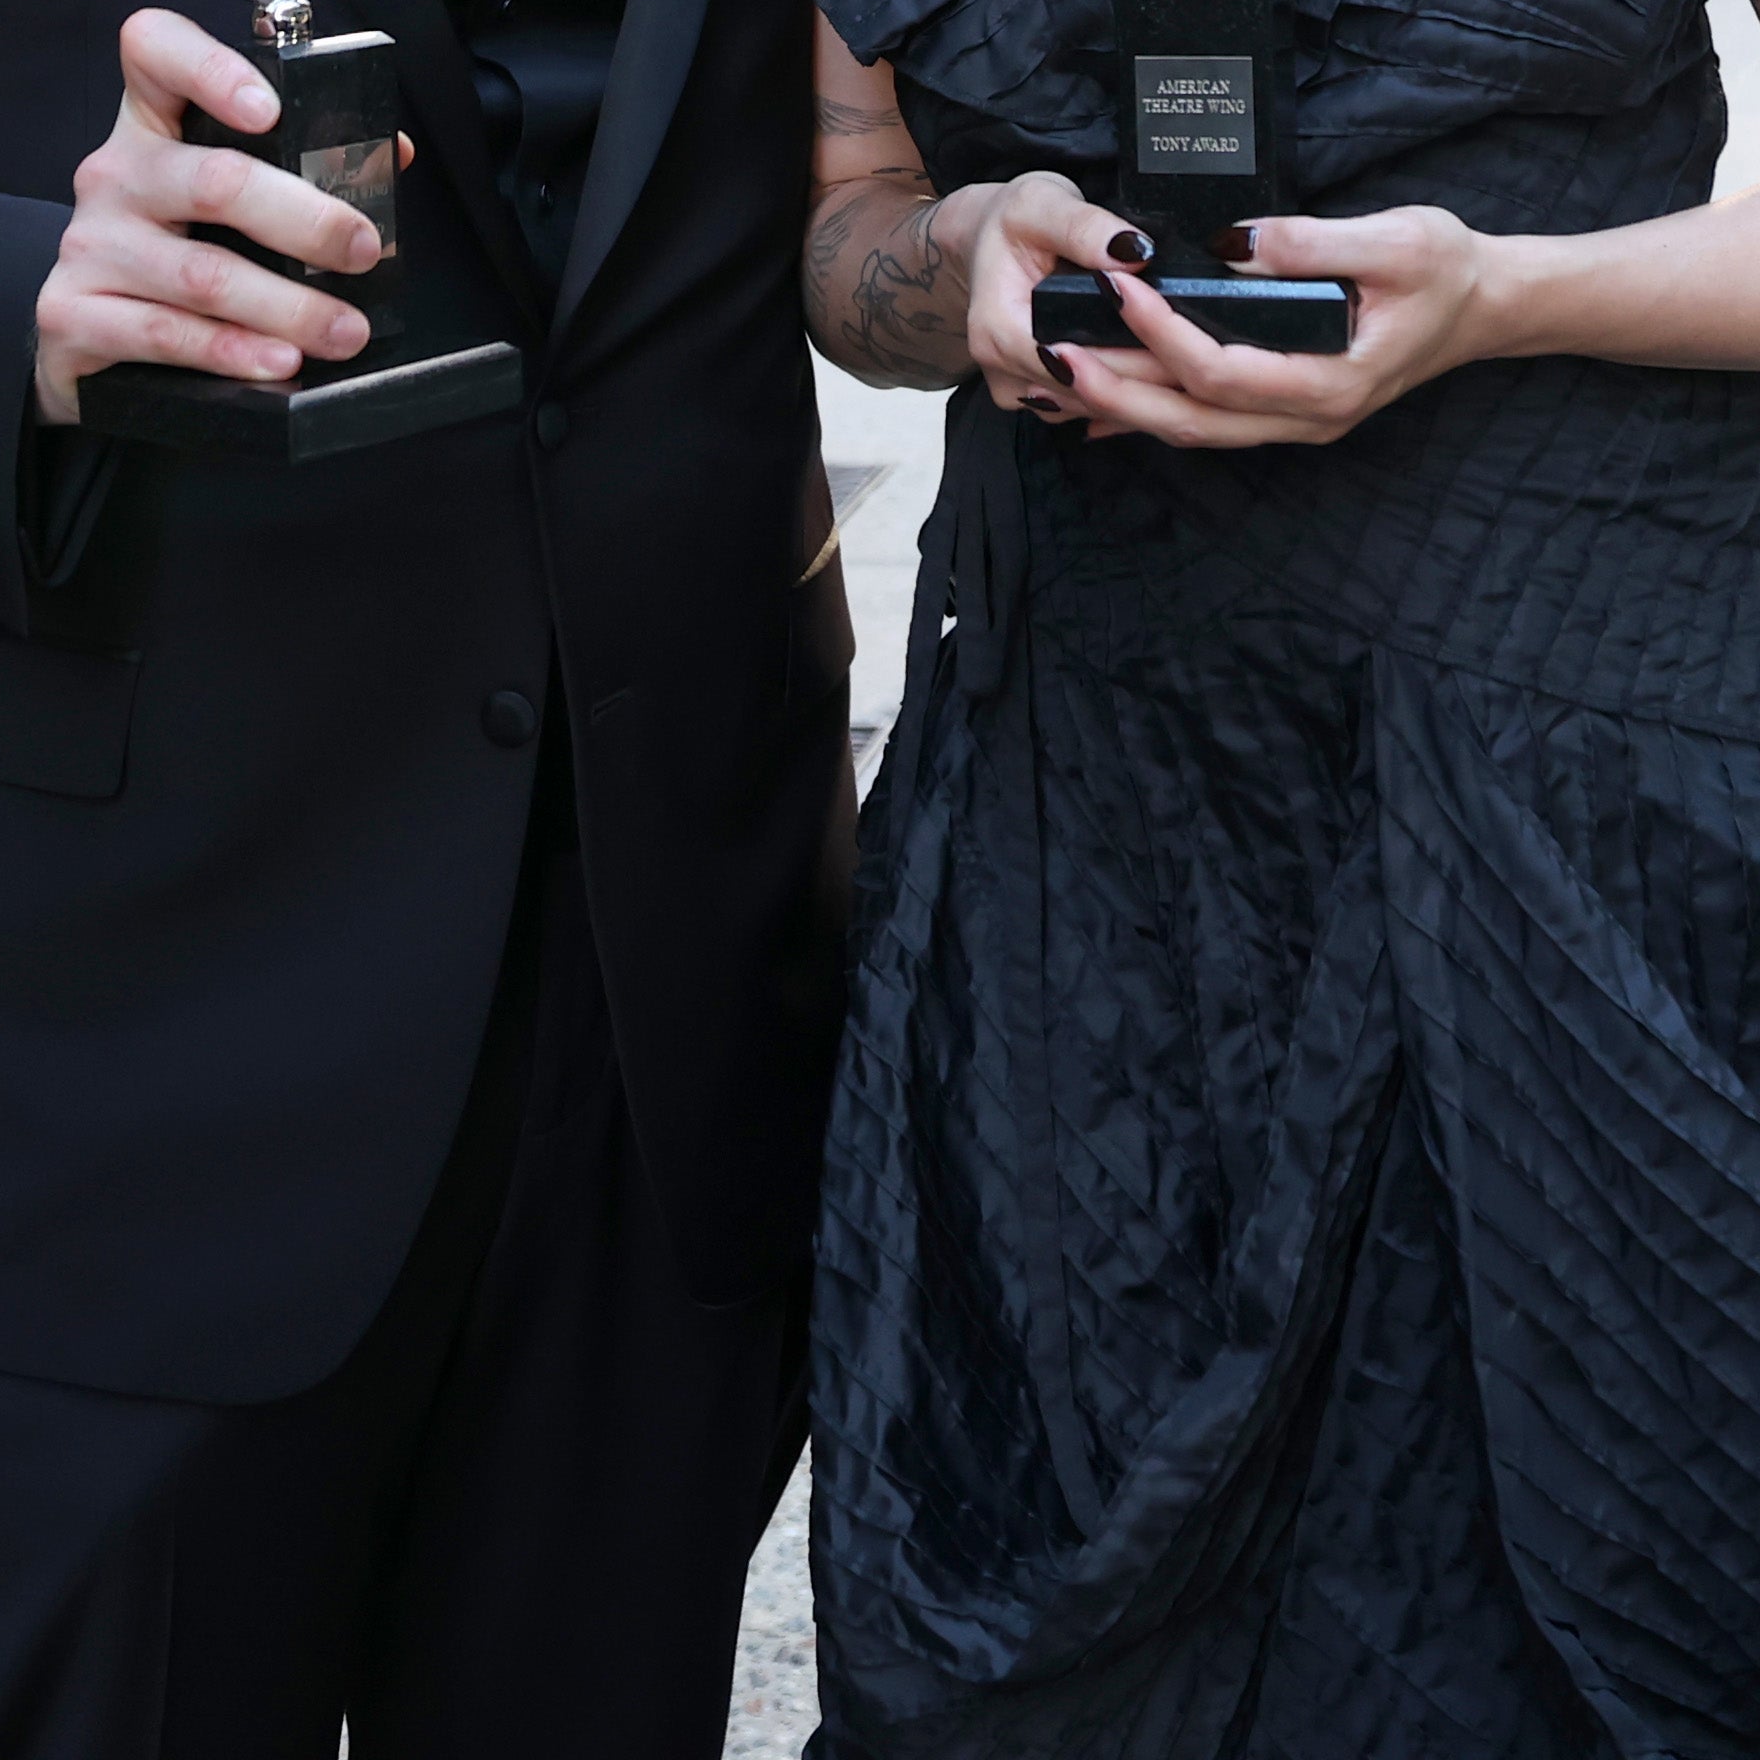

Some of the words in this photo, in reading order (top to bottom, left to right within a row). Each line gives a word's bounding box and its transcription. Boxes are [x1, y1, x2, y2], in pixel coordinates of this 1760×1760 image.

[1157, 79, 1231, 95] AMERICAN
[1142, 98, 1204, 114] THEATRE
[1207, 98, 1246, 115] WING
[1151, 136, 1190, 152] TONY
[1191, 136, 1240, 153] AWARD
